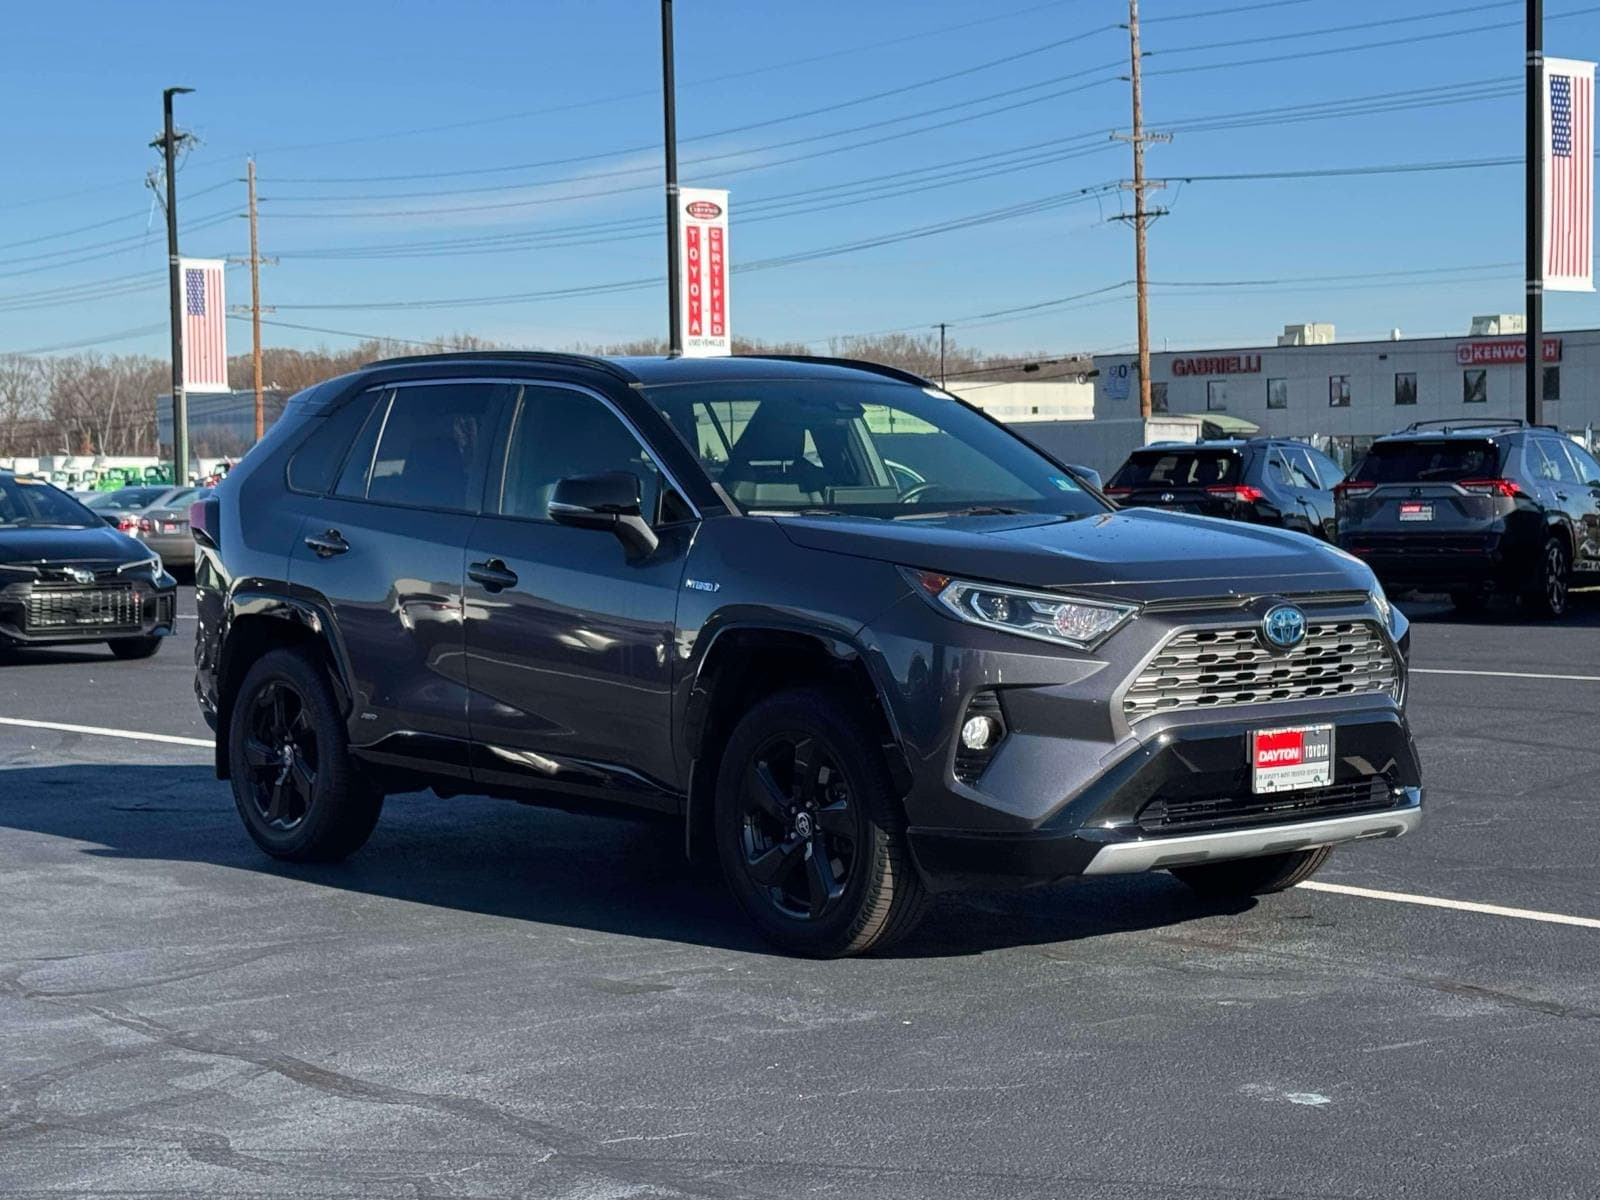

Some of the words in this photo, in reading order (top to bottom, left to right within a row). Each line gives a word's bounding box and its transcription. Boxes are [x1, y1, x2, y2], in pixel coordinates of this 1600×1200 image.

[689, 230, 701, 332] TOYOTA
[711, 229, 722, 334] CERTIFIED
[1473, 343, 1556, 359] KENWOH
[1172, 355, 1262, 376] GABRIELLI
[1259, 748, 1300, 763] DAYTON
[1305, 744, 1328, 758] TOYOTA
